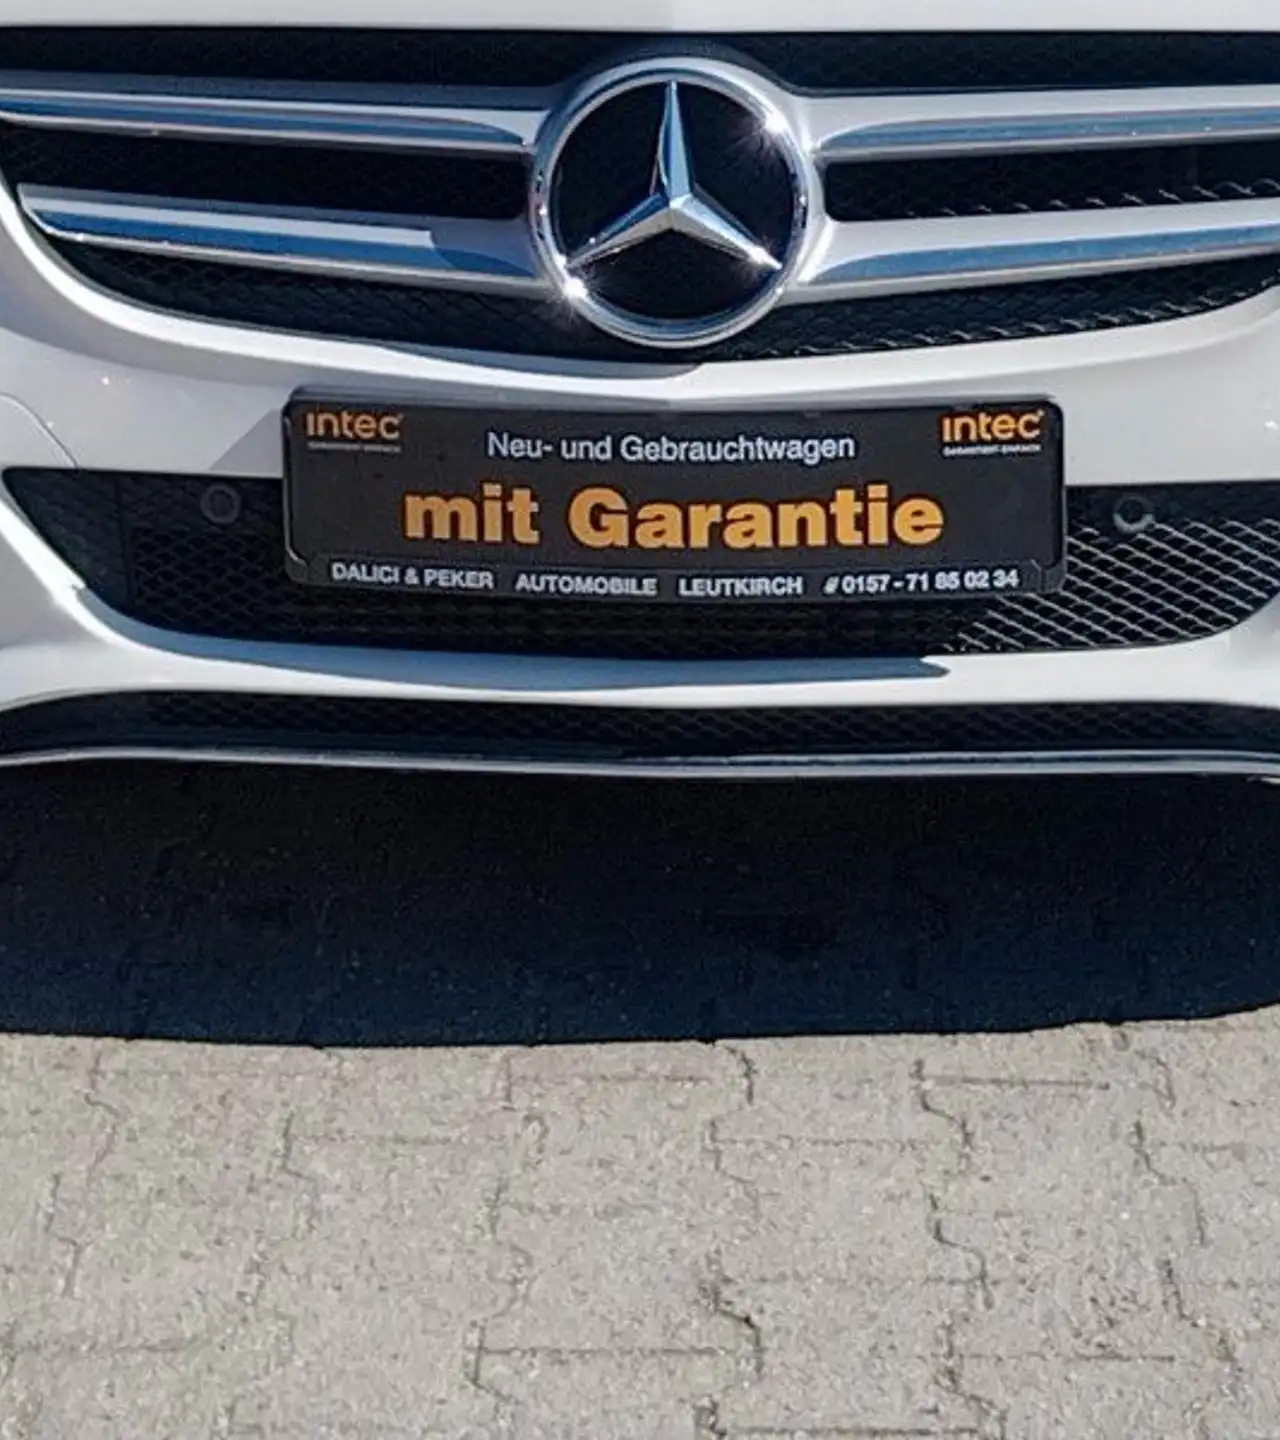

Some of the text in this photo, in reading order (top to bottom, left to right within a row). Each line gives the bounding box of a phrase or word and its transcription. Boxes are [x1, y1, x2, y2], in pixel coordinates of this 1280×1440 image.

[487, 432, 855, 465] Neu- und Gebrauchtwagen
[403, 484, 945, 549] mit Garantie
[404, 567, 419, 585] &
[424, 569, 494, 589] PEKER
[516, 573, 658, 595] AUTOMOBILE
[678, 575, 803, 596] LEUTKIRCH
[963, 570, 990, 590] 02
[992, 568, 1019, 588] 34
